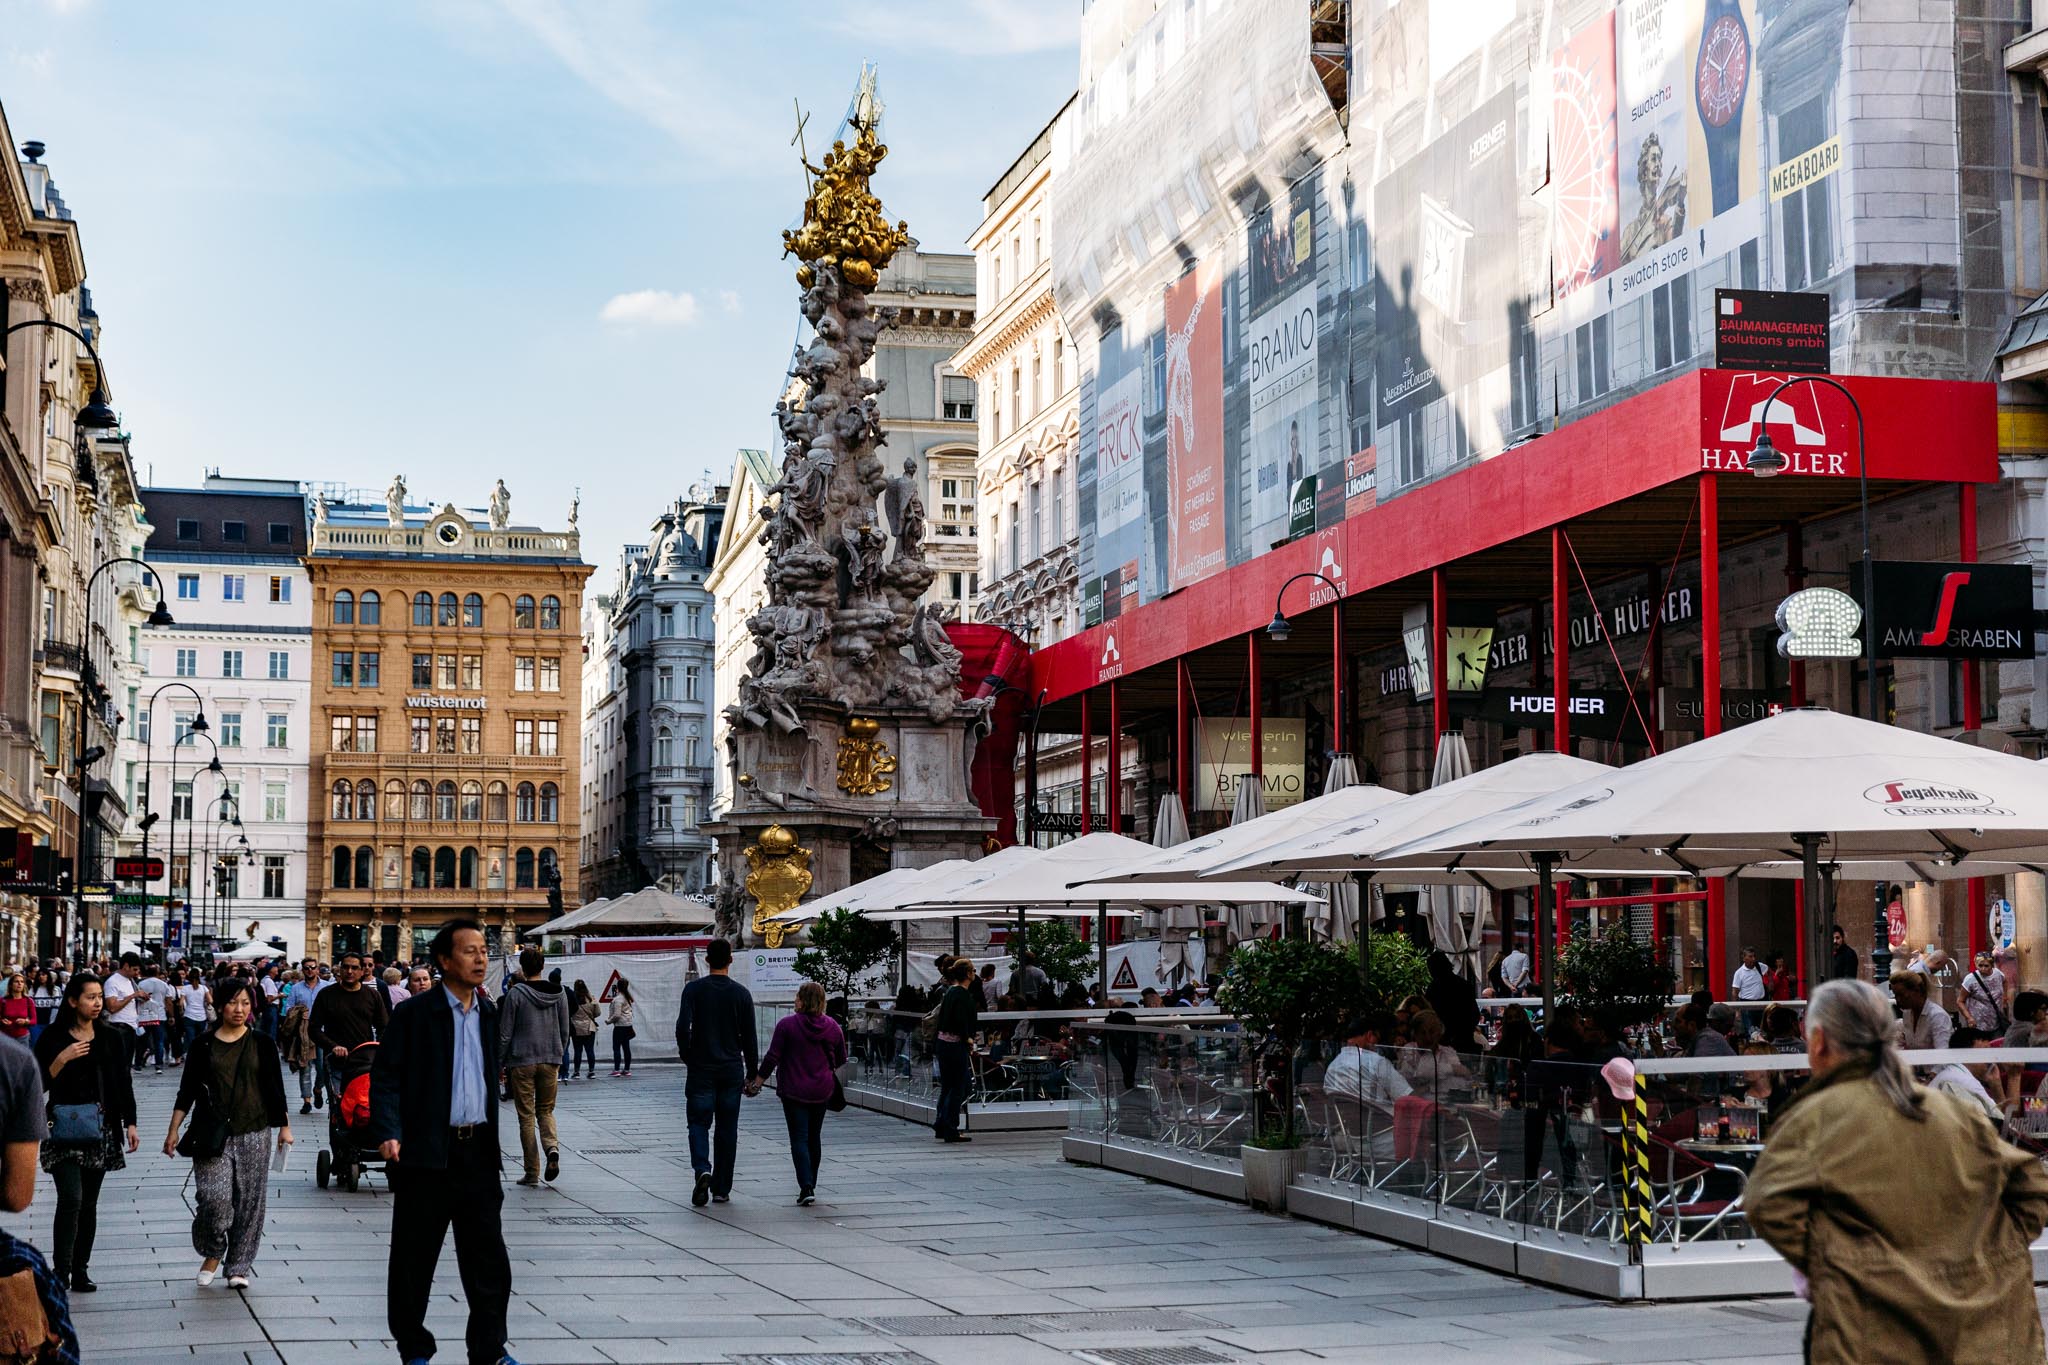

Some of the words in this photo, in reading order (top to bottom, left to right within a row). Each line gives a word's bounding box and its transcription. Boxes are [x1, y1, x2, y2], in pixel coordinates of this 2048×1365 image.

[1635, 0, 1668, 23] ALWA
[1636, 9, 1663, 40] WANT
[1631, 89, 1665, 122] swatch
[1772, 143, 1839, 193] MEGABOARD
[1622, 261, 1660, 292] swatch
[1661, 246, 1689, 273] store
[1720, 319, 1824, 336] BAUMANAGEMENT
[1251, 307, 1315, 384] BRAMO
[1720, 333, 1783, 347] solutions
[1786, 336, 1825, 349] gmbh
[1701, 448, 1846, 475] HADLER
[1293, 495, 1315, 517] ANZEL
[1883, 627, 1916, 646] AM
[1945, 629, 2022, 649] GRABEN
[406, 692, 488, 709] wüstenrot
[1675, 698, 1766, 719] swtch
[1222, 730, 1297, 742] wieerin
[1219, 774, 1300, 792] BRMO
[1885, 782, 1980, 804] Segafredo
[1896, 806, 2006, 816] ESPRESSO
